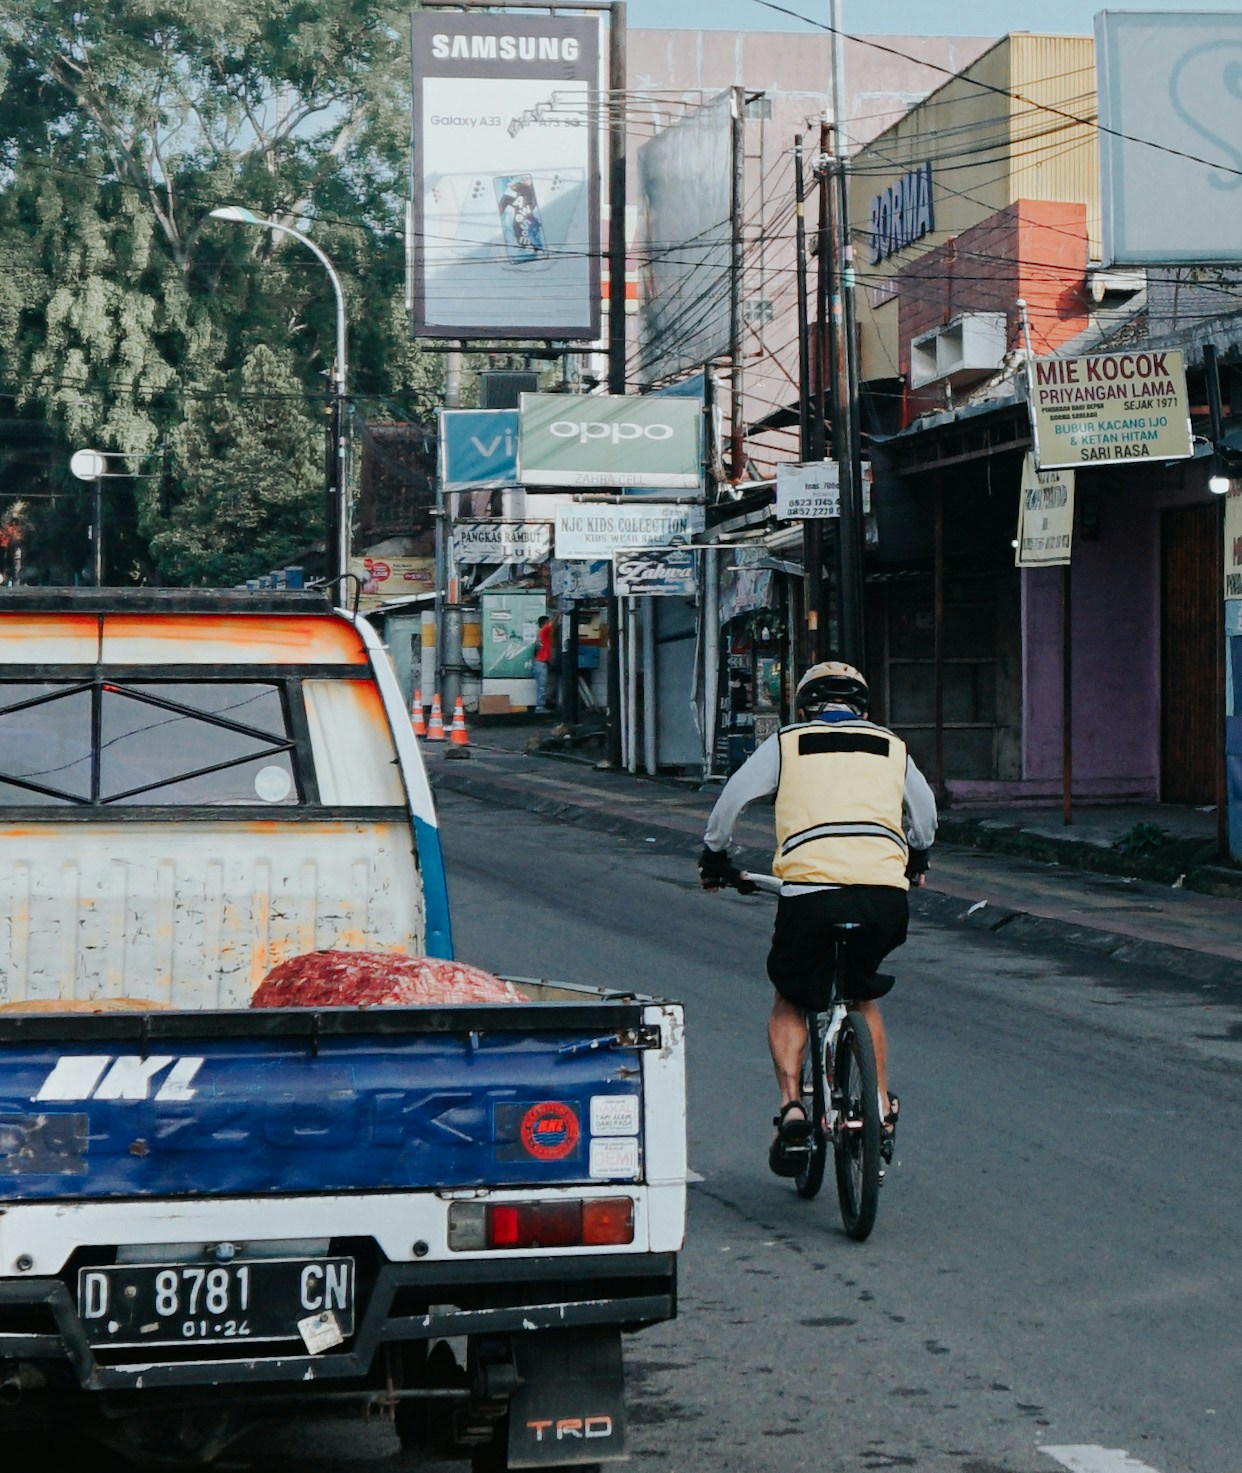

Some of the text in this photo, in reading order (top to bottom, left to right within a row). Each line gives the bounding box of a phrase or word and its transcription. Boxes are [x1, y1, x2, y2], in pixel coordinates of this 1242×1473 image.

[432, 34, 580, 61] SAMSUNG
[430, 114, 477, 129] Galaxy
[479, 116, 501, 127] A33
[868, 159, 935, 266] BORMA
[1036, 352, 1170, 385] MIE KOCOK
[1039, 380, 1176, 405] PRIYANGAN LAMA
[1124, 397, 1178, 411] SEJAK 1971
[549, 420, 674, 445] oppo
[1055, 416, 1168, 435] BUBUR KACANG IJO
[471, 428, 518, 457] vi
[1070, 430, 1159, 446] & KETAN HITAM
[1080, 443, 1150, 461] SARI RASA
[561, 517, 688, 533] NJC KIDS COLLECTION
[461, 531, 542, 543] PANGKAS RAMBUT
[585, 534, 608, 543] KIDS
[611, 534, 638, 543] WEAR
[502, 545, 542, 557] Luis
[85, 1263, 349, 1319] D 8781 CN
[526, 1414, 613, 1442] TRD
